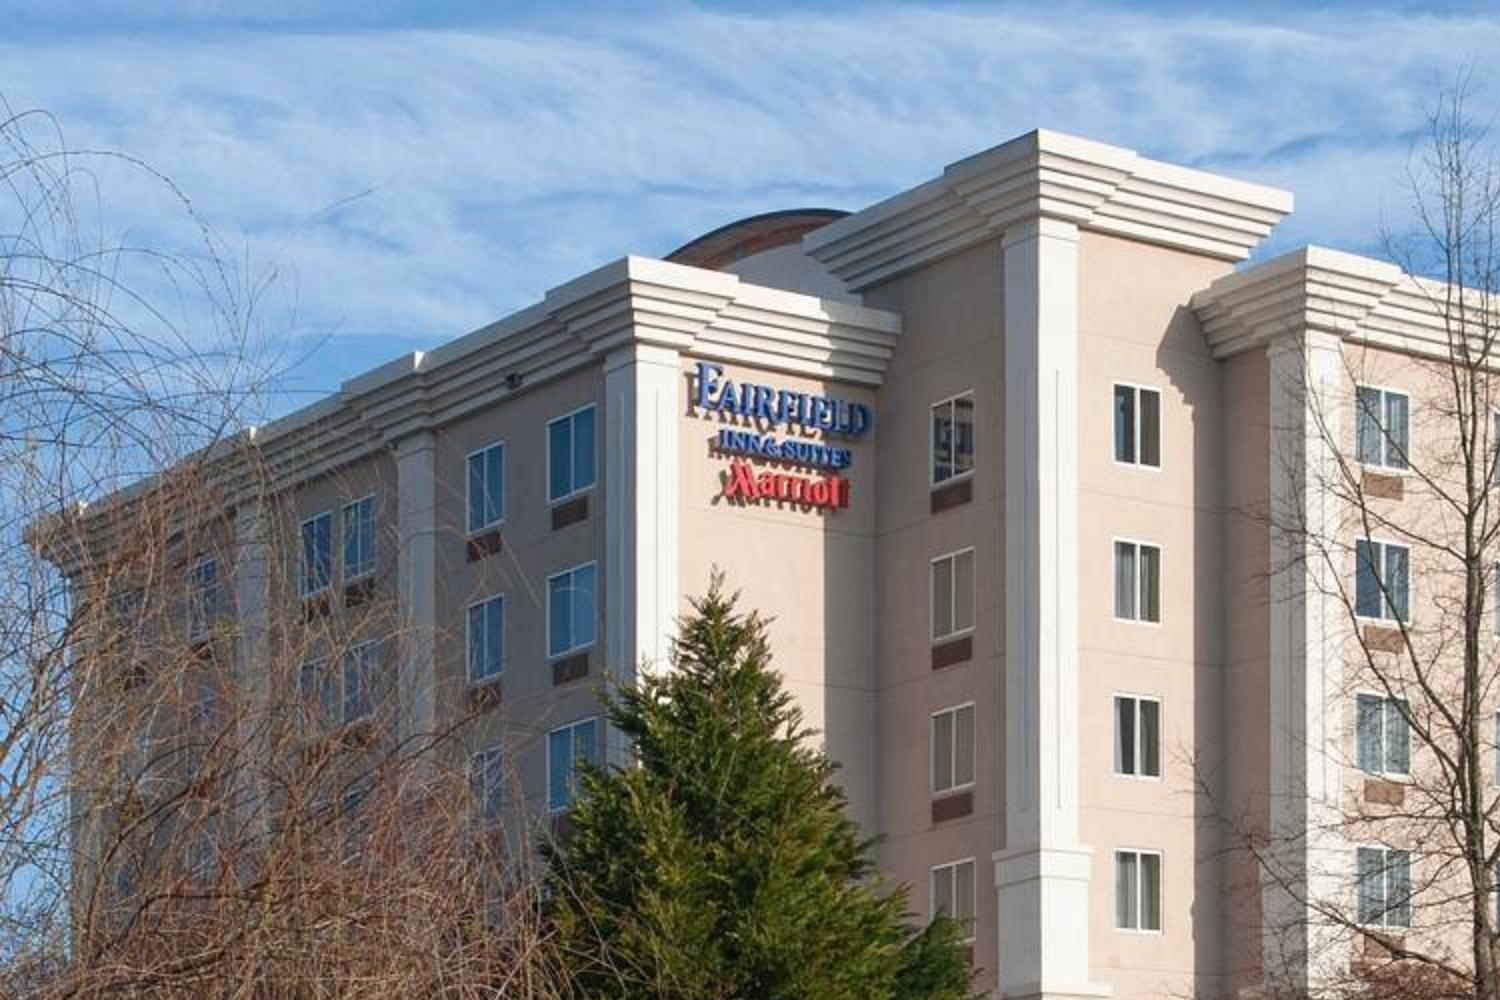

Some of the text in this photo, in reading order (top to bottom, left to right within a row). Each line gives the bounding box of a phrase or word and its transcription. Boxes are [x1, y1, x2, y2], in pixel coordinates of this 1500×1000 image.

[696, 362, 872, 436] FAIRFIELD
[718, 428, 851, 469] INN & SUITES
